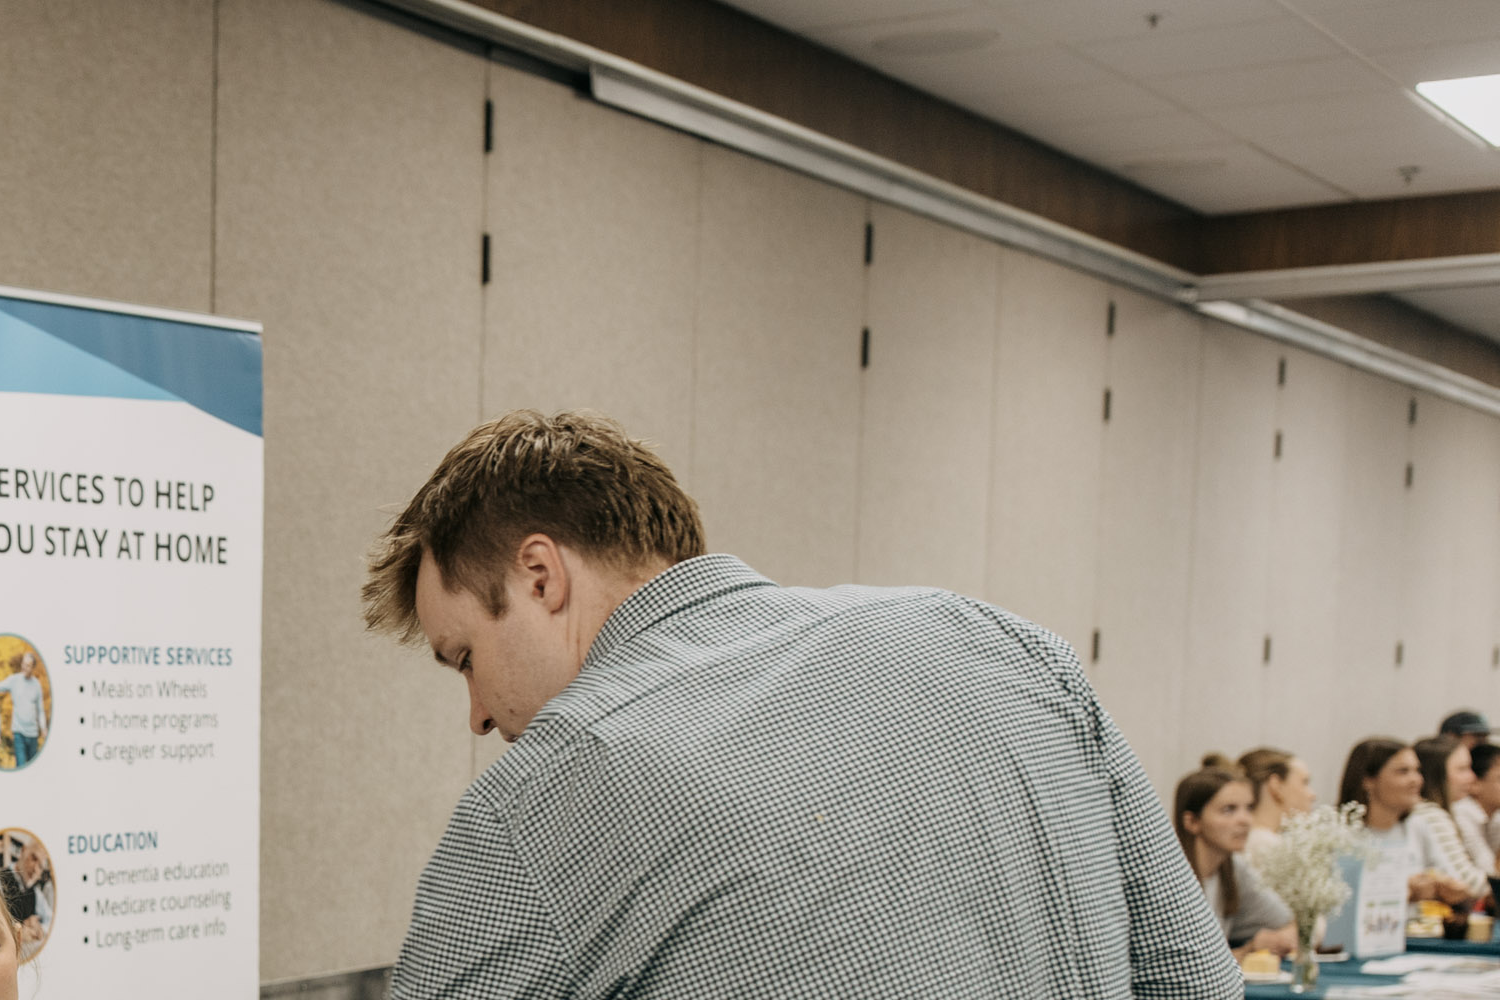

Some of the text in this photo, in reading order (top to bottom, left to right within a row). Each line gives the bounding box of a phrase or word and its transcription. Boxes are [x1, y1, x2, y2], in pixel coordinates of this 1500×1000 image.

[114, 476, 145, 507] TO
[155, 480, 215, 512] HELP
[44, 526, 108, 558] STAY
[117, 530, 145, 560] AT
[155, 532, 228, 565] HOME
[64, 645, 233, 666] SUPPORTIVE SERVICES
[92, 681, 208, 698] Meals on Wheels
[92, 712, 219, 734] In-home programs
[92, 741, 215, 765] Caregiver support
[67, 831, 159, 855] EDUCATION
[95, 861, 230, 887] Dementia education
[96, 890, 232, 917] Medicare counseling
[96, 917, 227, 951] Long-term care info
